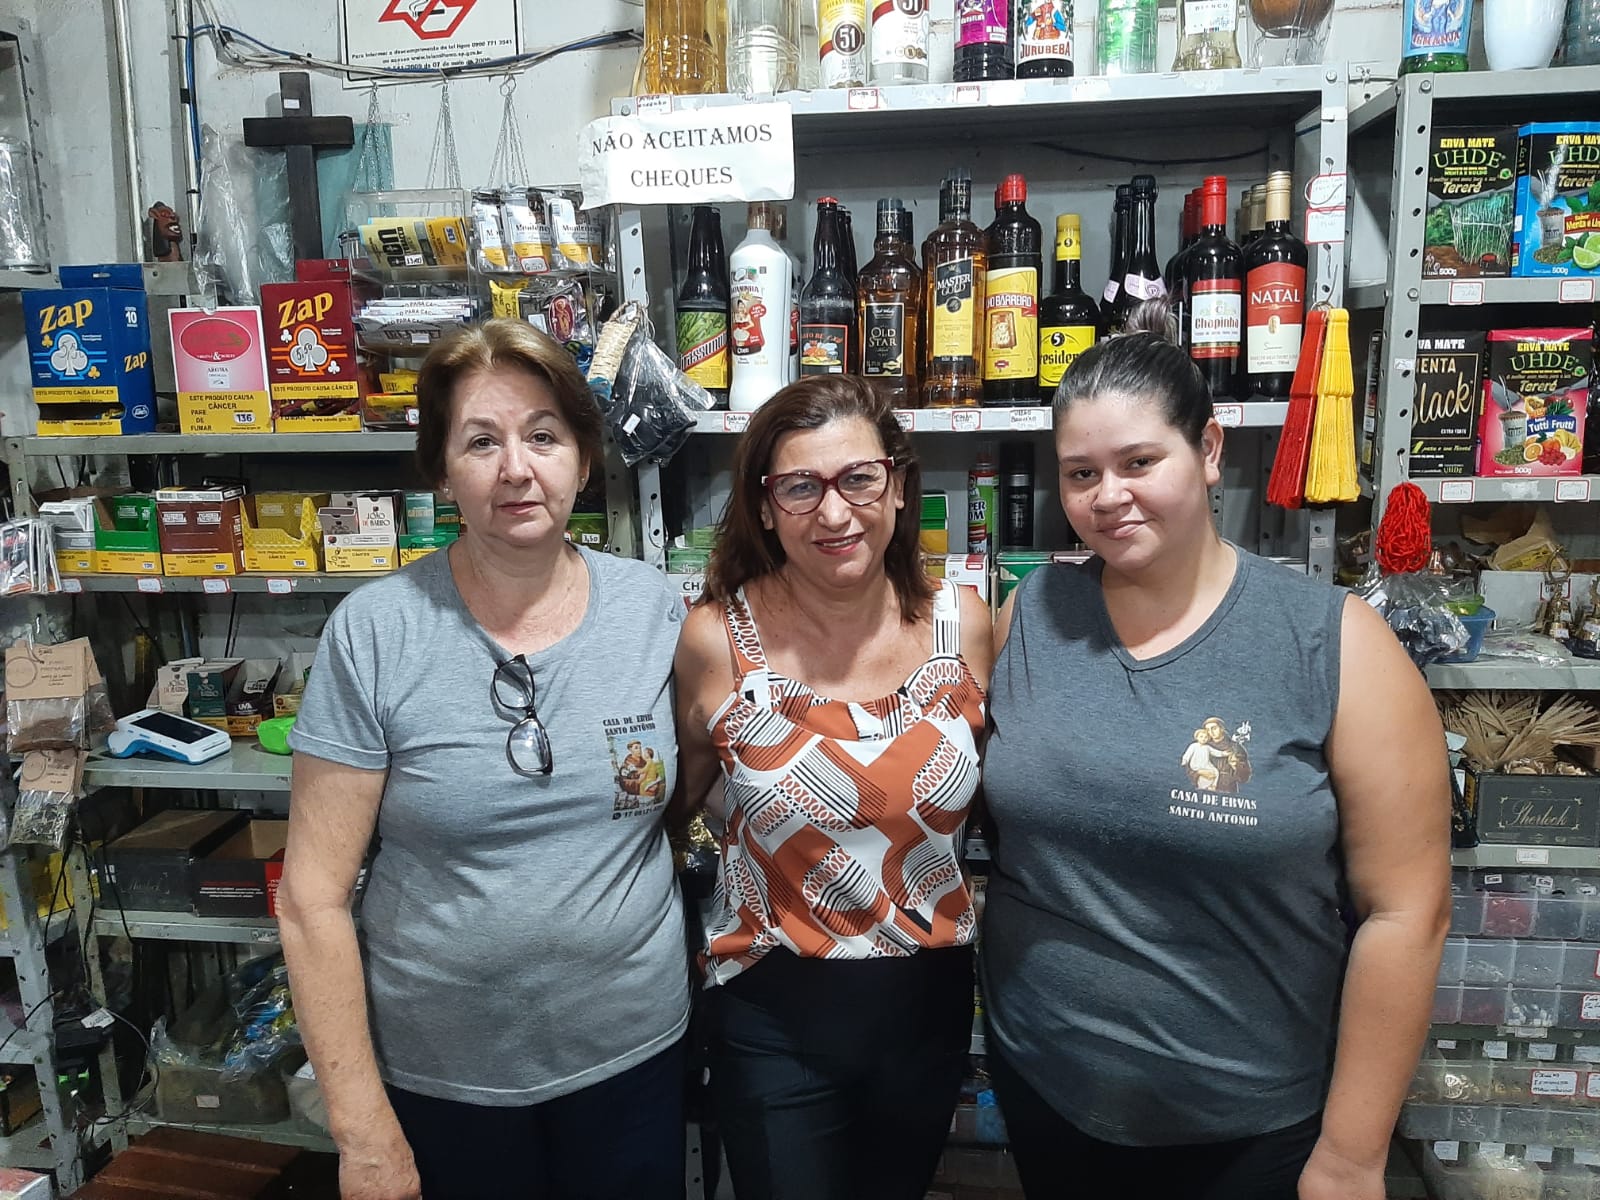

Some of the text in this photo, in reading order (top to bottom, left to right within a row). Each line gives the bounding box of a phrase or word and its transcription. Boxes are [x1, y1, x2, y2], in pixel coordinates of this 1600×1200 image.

[839, 28, 856, 48] 51
[1020, 41, 1071, 59] JURUBEBA
[592, 124, 773, 157] NÃO ACEITAMOS
[1440, 138, 1495, 148] ERVA MATE
[1556, 135, 1600, 145] ERVA MAT
[1433, 148, 1502, 168] UHDE
[1548, 145, 1600, 165] UHD
[631, 167, 733, 188] CHEQUES
[1559, 175, 1595, 188] Tereré
[1442, 181, 1482, 193] Tereré
[1551, 267, 1568, 275] 500g
[937, 273, 971, 290] MASTER
[941, 284, 966, 297] GOLD
[1251, 289, 1300, 304] NATAL
[40, 299, 93, 334] Zap
[279, 292, 333, 328] Zap
[126, 311, 138, 323] 10
[1195, 316, 1239, 330] Chapinha
[871, 327, 897, 338] OLD
[1054, 333, 1061, 345] 5
[869, 338, 897, 348] STAR
[1418, 339, 1465, 349] VA MATE
[1517, 342, 1569, 352] ERVA MATE
[124, 352, 147, 373] Zap
[1040, 350, 1080, 364] residen
[1509, 353, 1577, 372] UHDE
[1520, 380, 1558, 392] Tereré
[208, 402, 237, 410] CÂNCER
[237, 413, 252, 422] 136
[1529, 420, 1575, 432] Tutti Frutti
[968, 501, 986, 511] PER
[683, 581, 706, 592] CH
[603, 717, 620, 726] CASA
[623, 716, 633, 724] DE
[605, 727, 627, 737] SANTO
[1171, 789, 1257, 810] CASA DE ERVAS
[1169, 806, 1258, 826] SANTO ANTONIO
[1506, 801, 1571, 826] Sherlock
